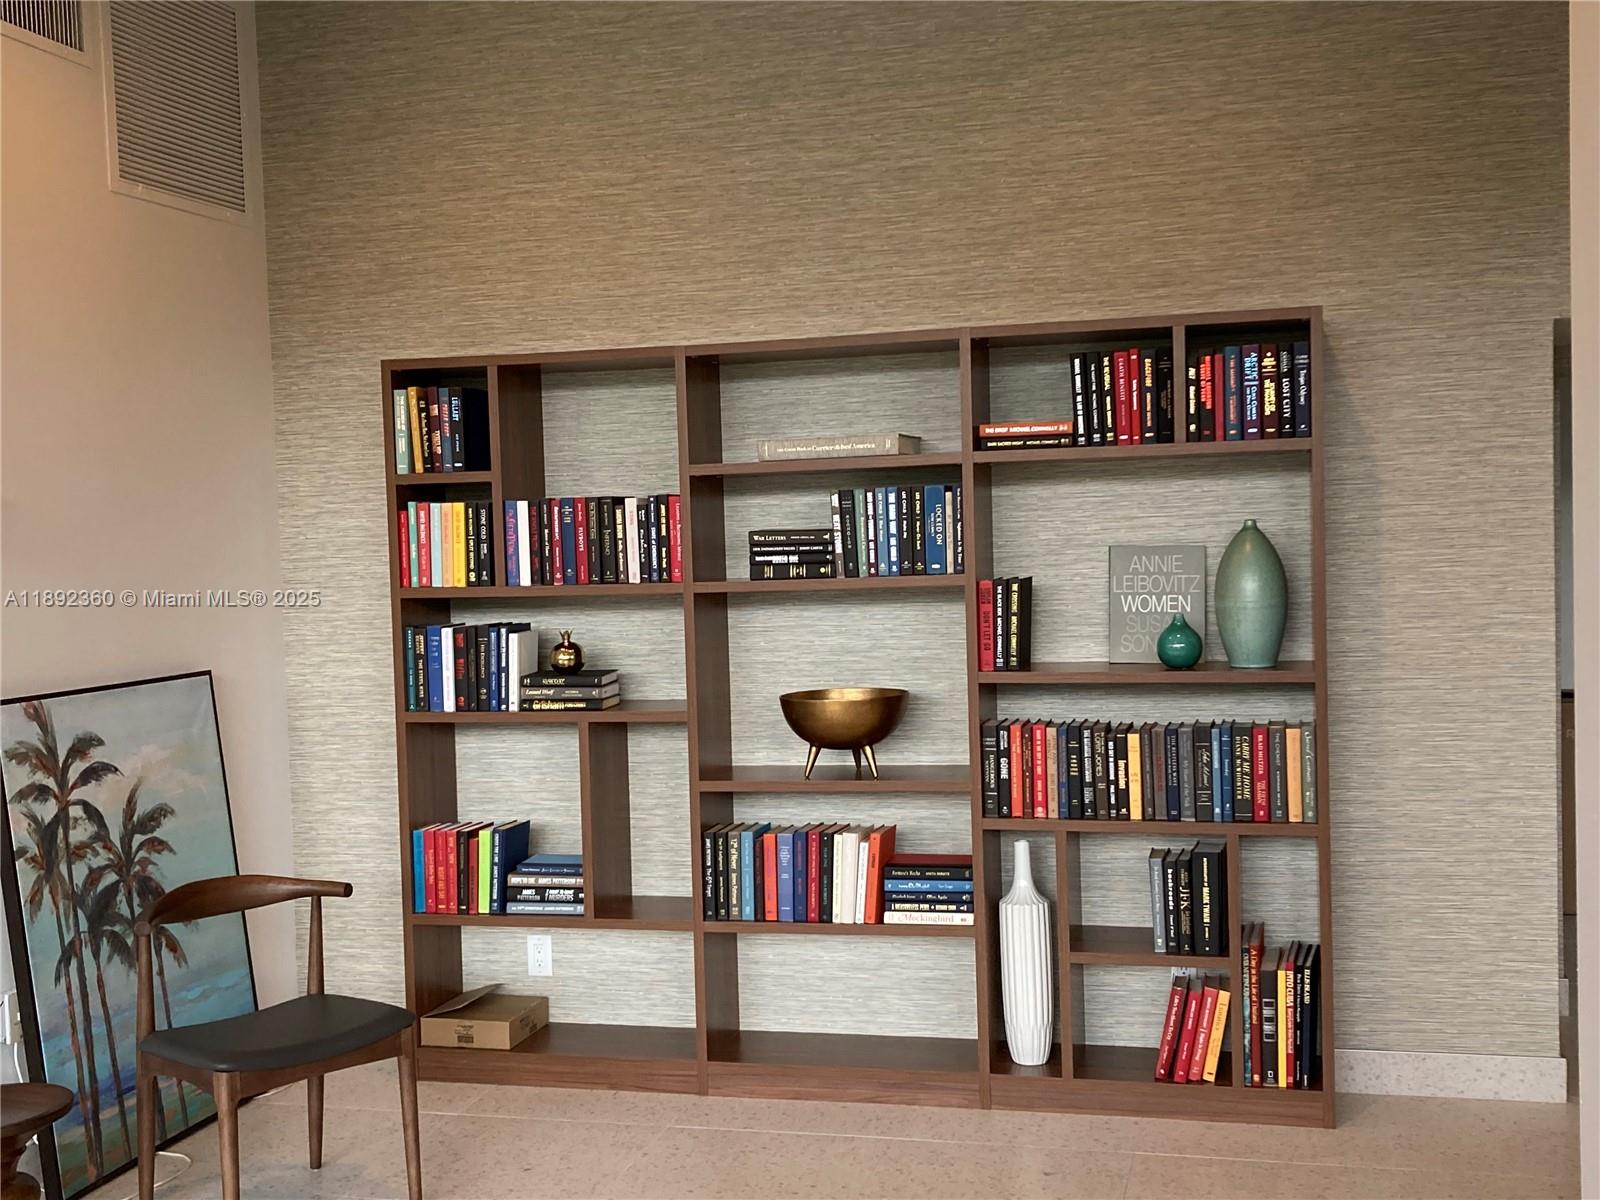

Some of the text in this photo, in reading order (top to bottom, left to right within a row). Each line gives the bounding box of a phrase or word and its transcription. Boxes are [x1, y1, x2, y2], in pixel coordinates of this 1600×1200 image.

[1282, 378, 1290, 397] LOST
[936, 534, 942, 545] ON
[1129, 555, 1184, 572] ANNIE
[1113, 575, 1200, 592] LEIBOVITZ
[1121, 594, 1191, 612] WOMEN
[984, 642, 991, 651] GO
[1242, 736, 1250, 760] CARRY
[1118, 760, 1127, 789] Invasion
[1243, 761, 1250, 773] ME
[1180, 886, 1190, 909] JFK
